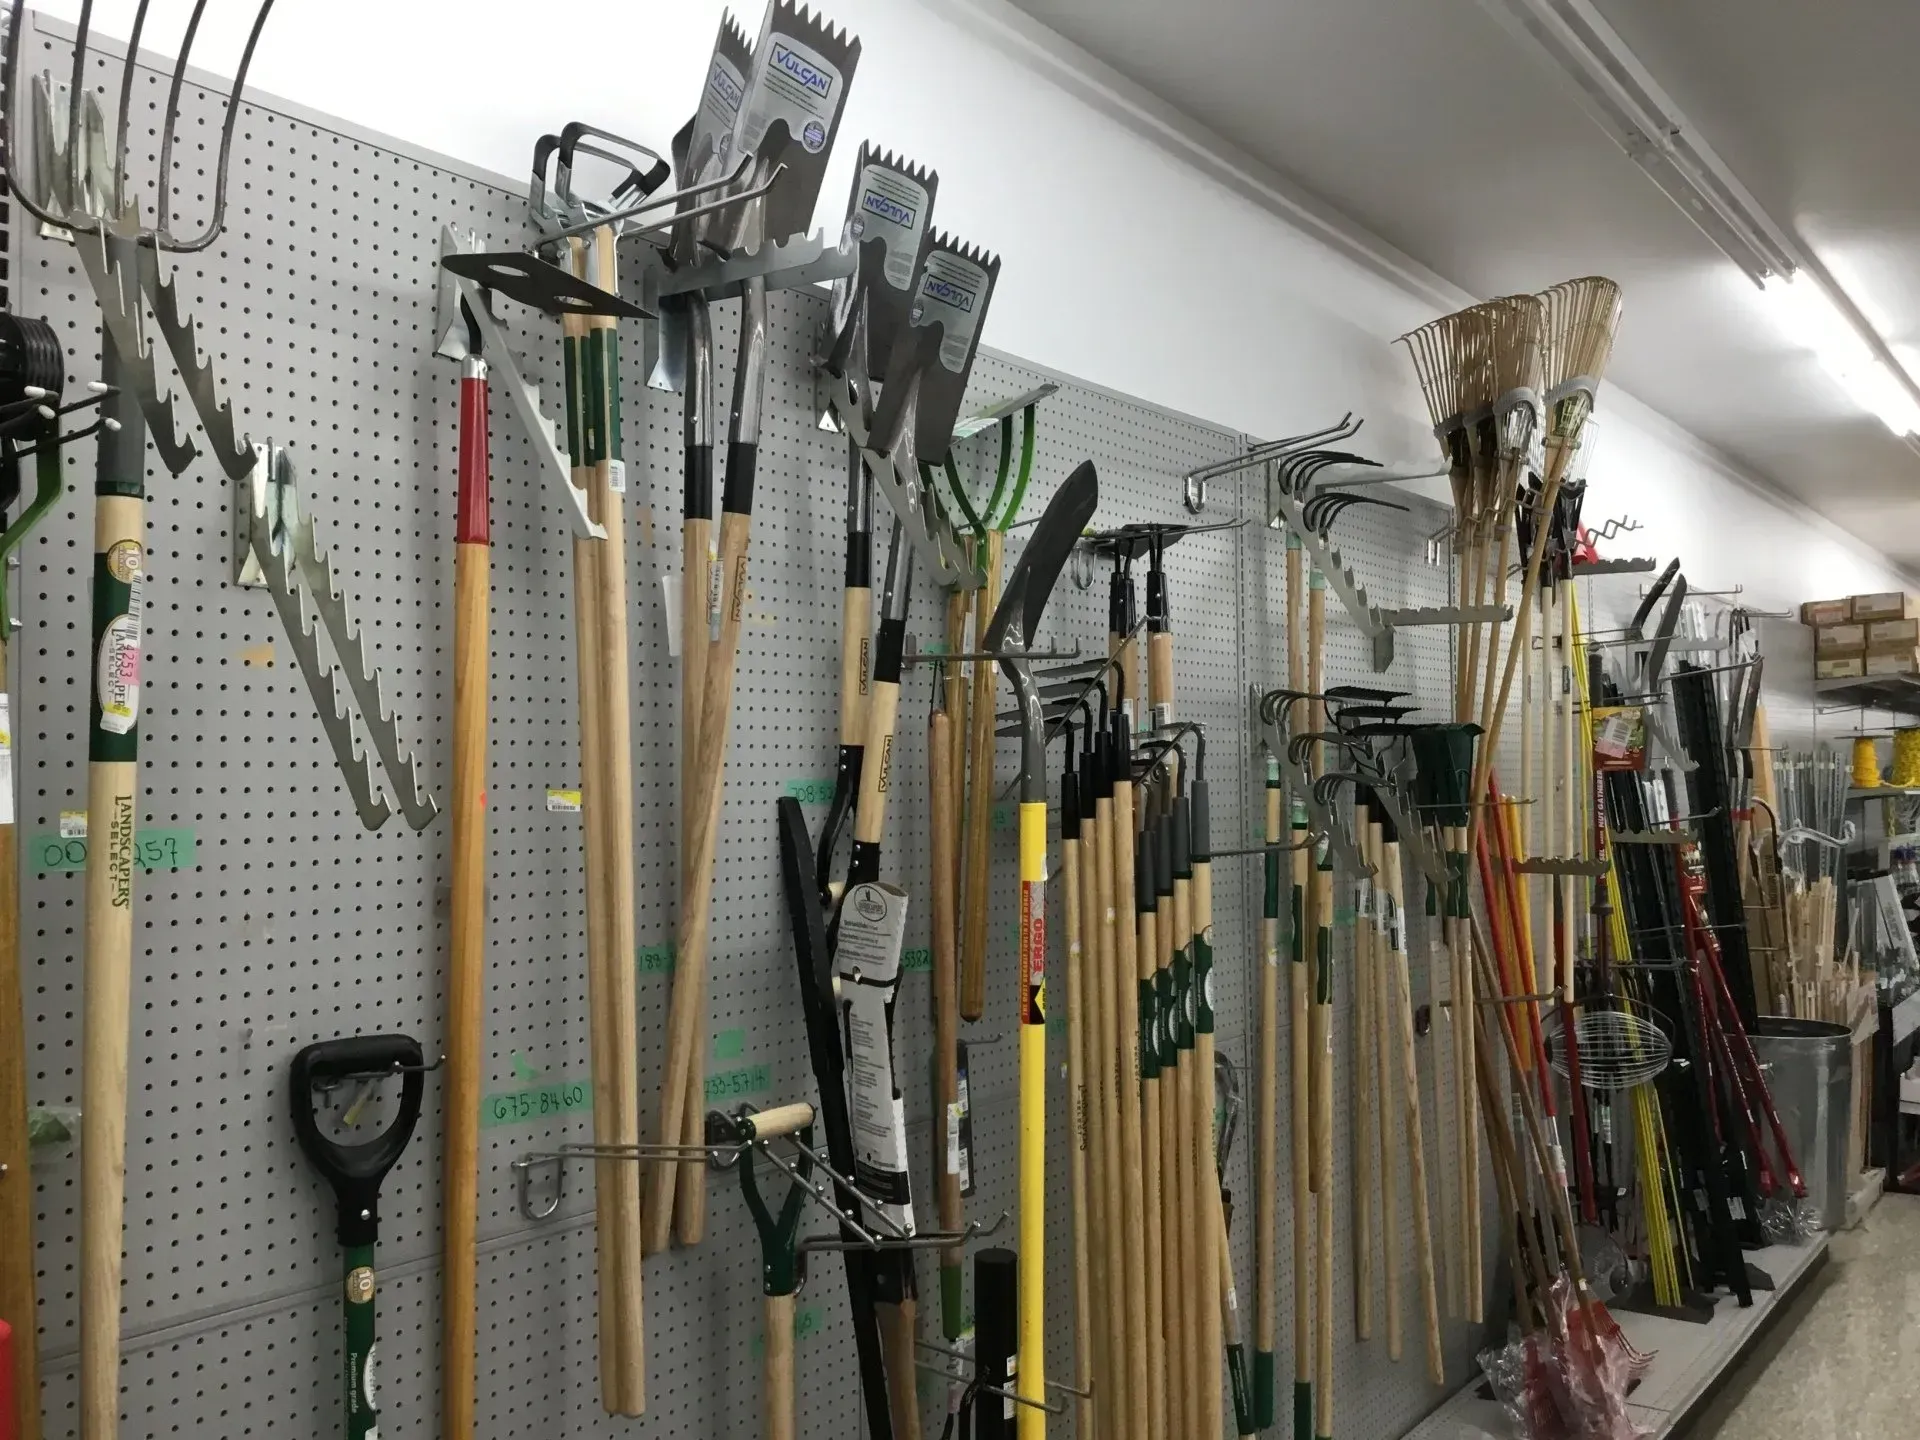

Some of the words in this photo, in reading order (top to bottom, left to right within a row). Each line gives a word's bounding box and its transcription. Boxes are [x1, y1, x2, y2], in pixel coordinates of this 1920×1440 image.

[712, 67, 740, 106] VULCAN
[775, 49, 828, 92] VULCAN
[865, 194, 910, 224] VULCAN
[926, 280, 970, 307] VULCAN
[120, 644, 135, 677] 4253
[861, 640, 869, 692] VULCAN
[879, 737, 892, 790] VULCAN
[110, 822, 119, 881] SELECT
[112, 795, 132, 907] LANDSCAPERS
[1033, 918, 1043, 973] ERGO
[494, 1086, 583, 1119] 675-8460
[359, 1270, 371, 1291] 10
[350, 1352, 358, 1389] Premium
[351, 1390, 359, 1413] grade
